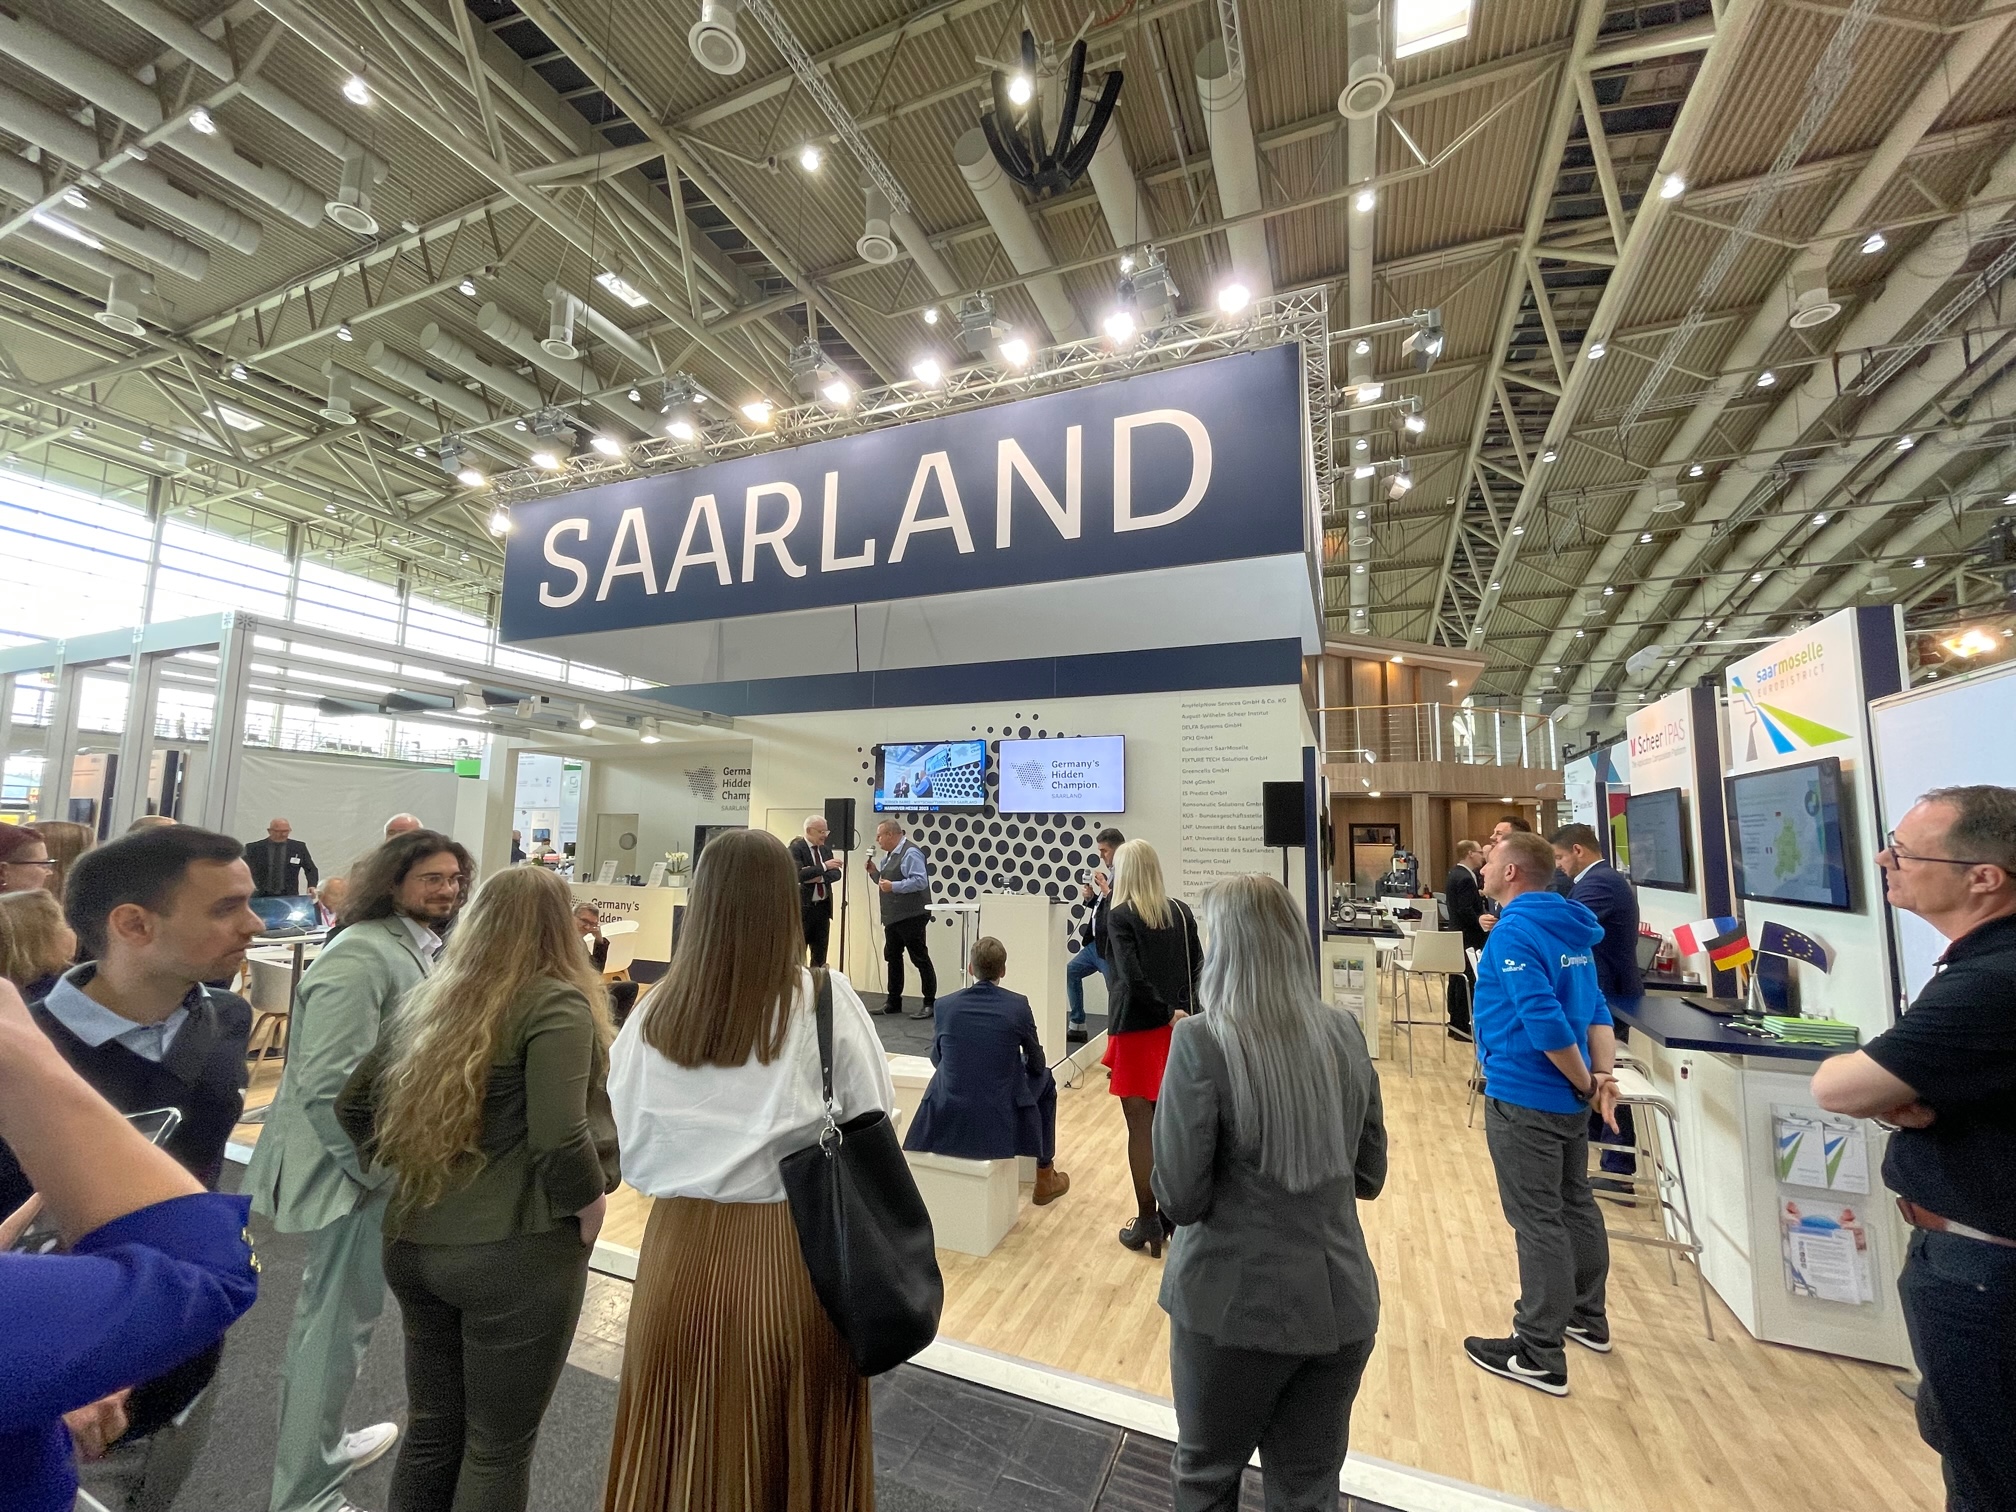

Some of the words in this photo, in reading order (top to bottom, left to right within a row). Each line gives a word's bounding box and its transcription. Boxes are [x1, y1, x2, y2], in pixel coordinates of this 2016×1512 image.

[539, 408, 1213, 608] SAARLAND
[1756, 642, 1823, 683] saarmoselle
[1757, 663, 1825, 697] EURODISTRICT
[1637, 732, 1663, 755] Scheer
[1667, 718, 1686, 745] PAS
[1051, 760, 1100, 770] Germany's
[723, 766, 751, 776] Germa
[1051, 771, 1084, 779] Hidden
[1051, 781, 1100, 791] Champion.
[721, 790, 750, 802] Champ
[599, 912, 623, 923] dden
